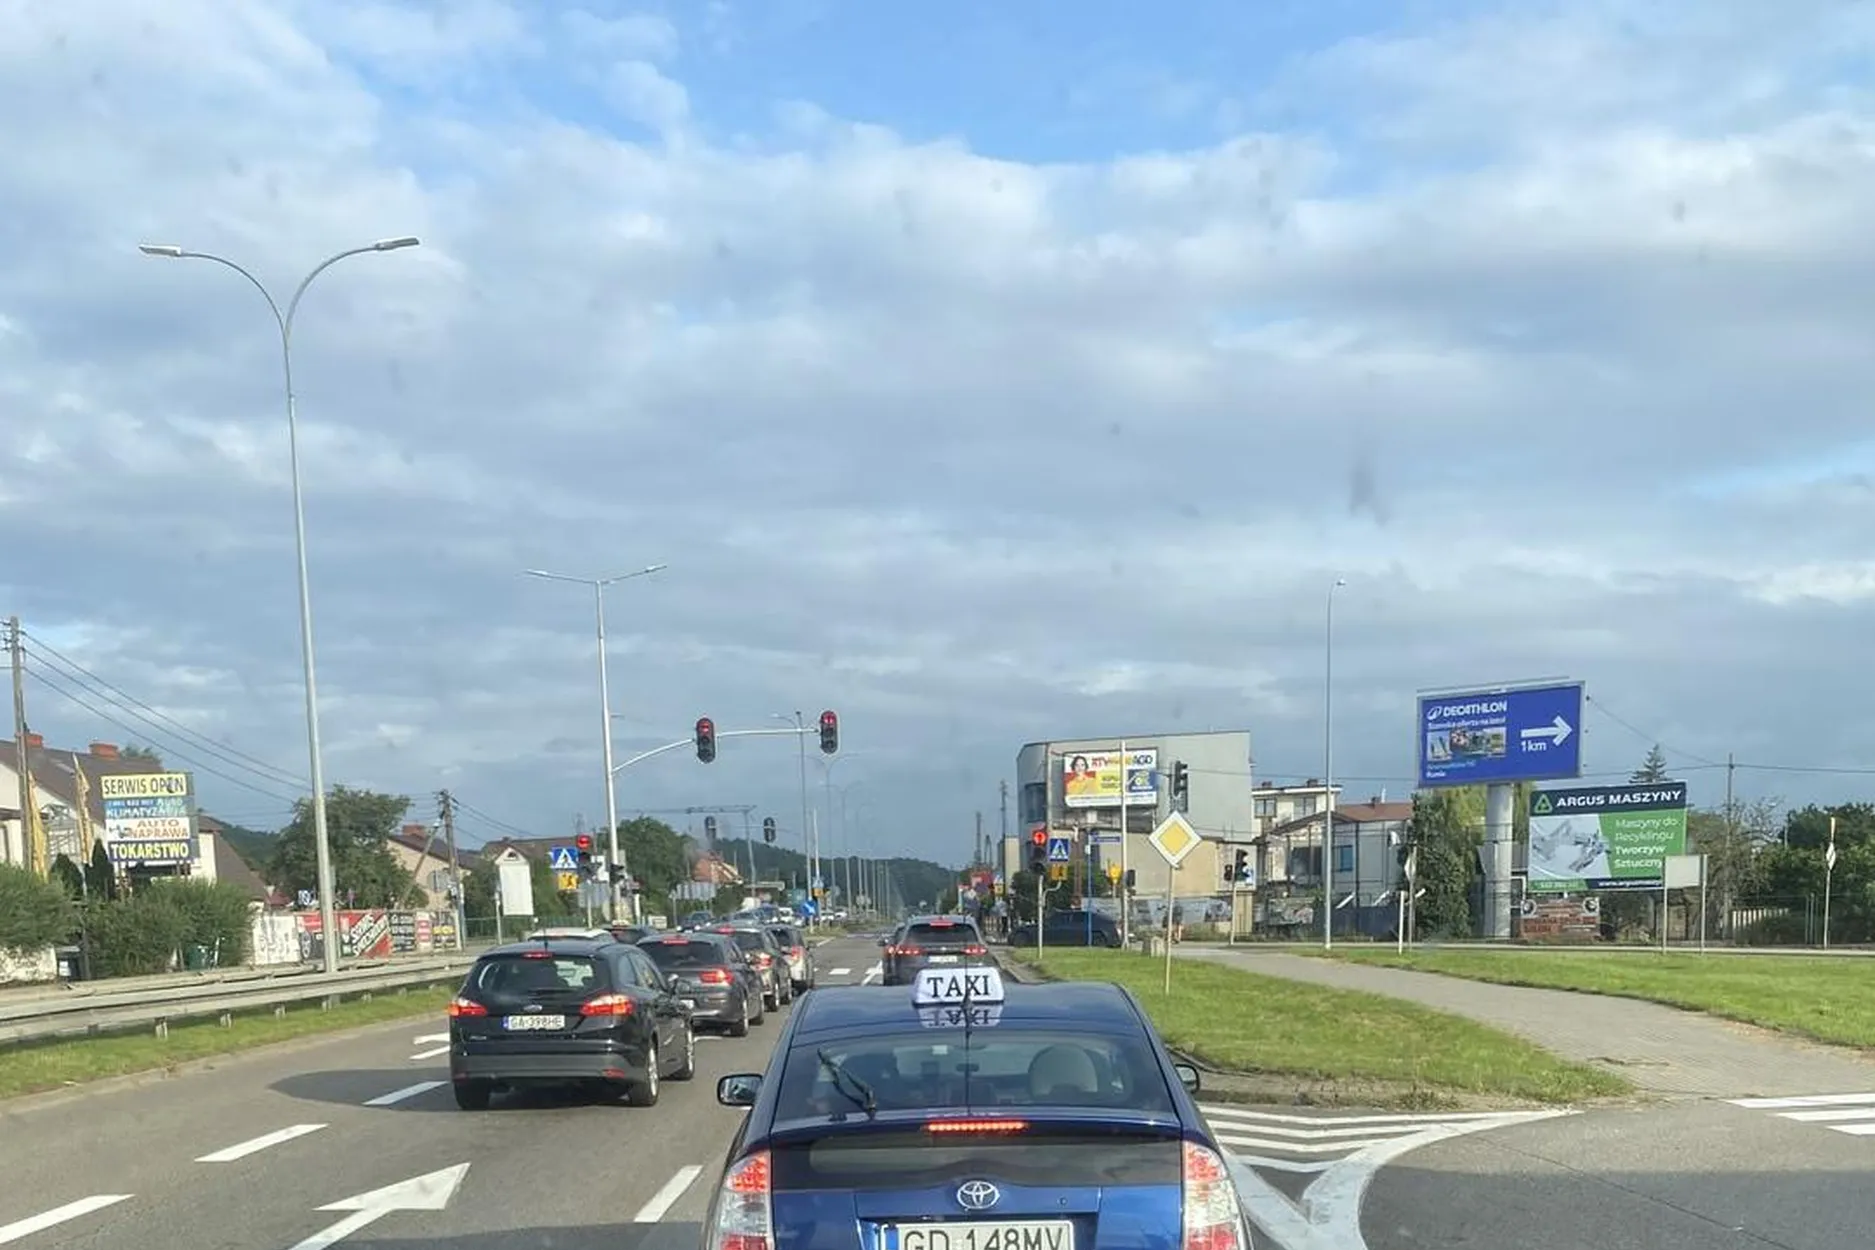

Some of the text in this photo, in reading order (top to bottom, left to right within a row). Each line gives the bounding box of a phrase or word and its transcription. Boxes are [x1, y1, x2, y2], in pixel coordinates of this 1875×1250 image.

[1443, 701, 1507, 717] DECATHLON
[1527, 741, 1547, 751] km
[103, 778, 147, 795] SERWIS
[1556, 790, 1682, 807] ARGUS MASZYNY
[137, 819, 179, 828] AUTO
[1615, 816, 1678, 830] Maszyny do
[110, 843, 189, 859] TOKARSTWO
[1615, 845, 1667, 857] Tworzyw
[1614, 858, 1662, 868] Sztuczny
[926, 975, 991, 998] TAXI
